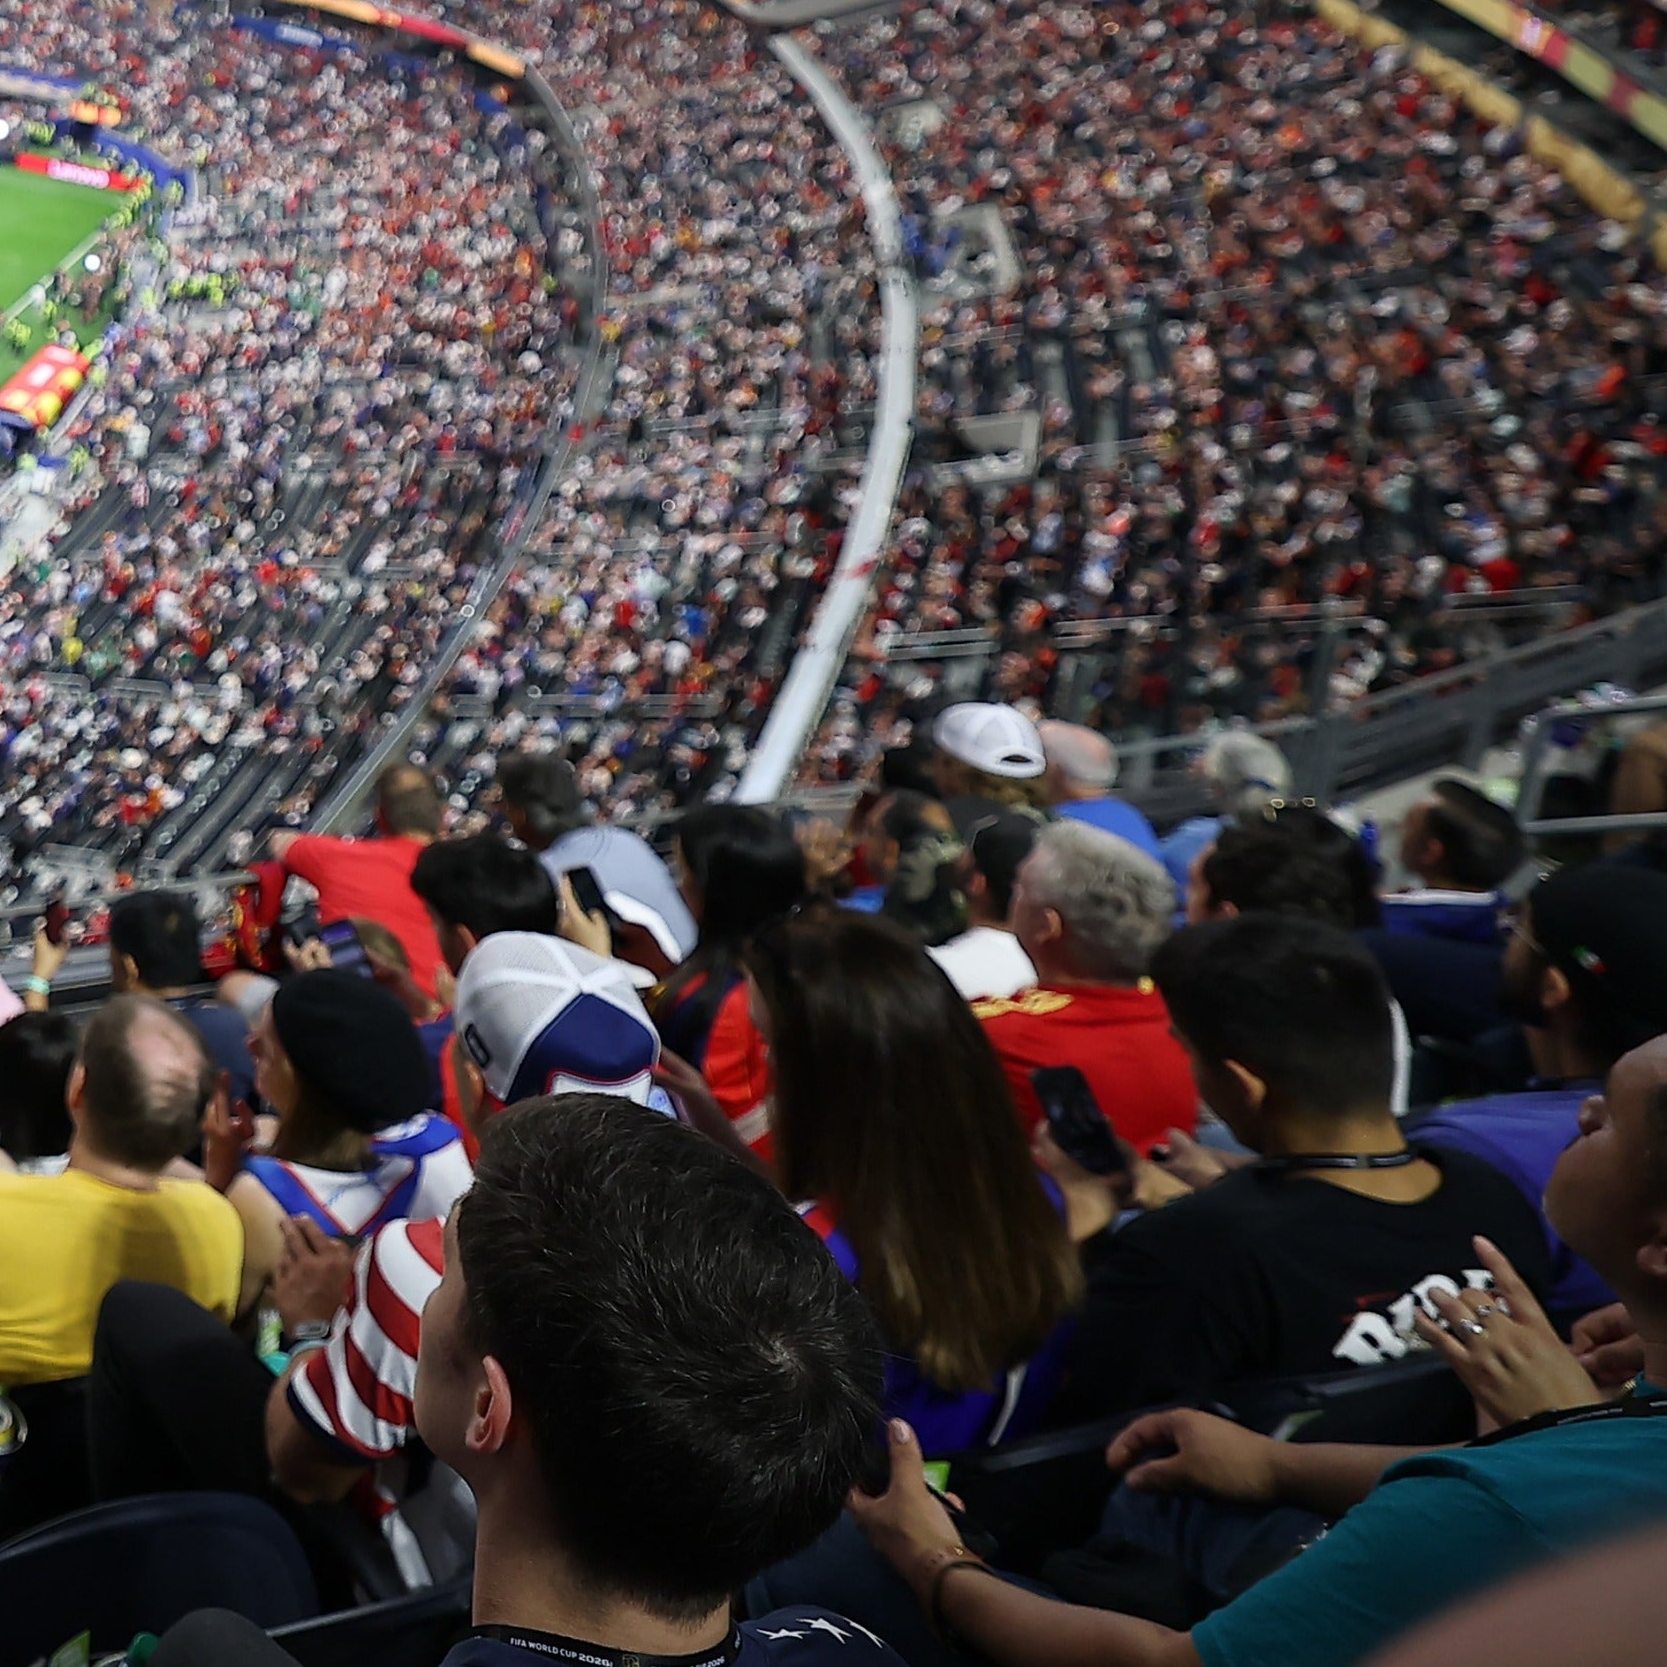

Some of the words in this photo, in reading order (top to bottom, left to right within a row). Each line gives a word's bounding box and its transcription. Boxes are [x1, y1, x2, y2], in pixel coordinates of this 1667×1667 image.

[510, 1637, 527, 1648] FIFA
[528, 1641, 559, 1655] WORLD
[560, 1648, 578, 1659] CUP
